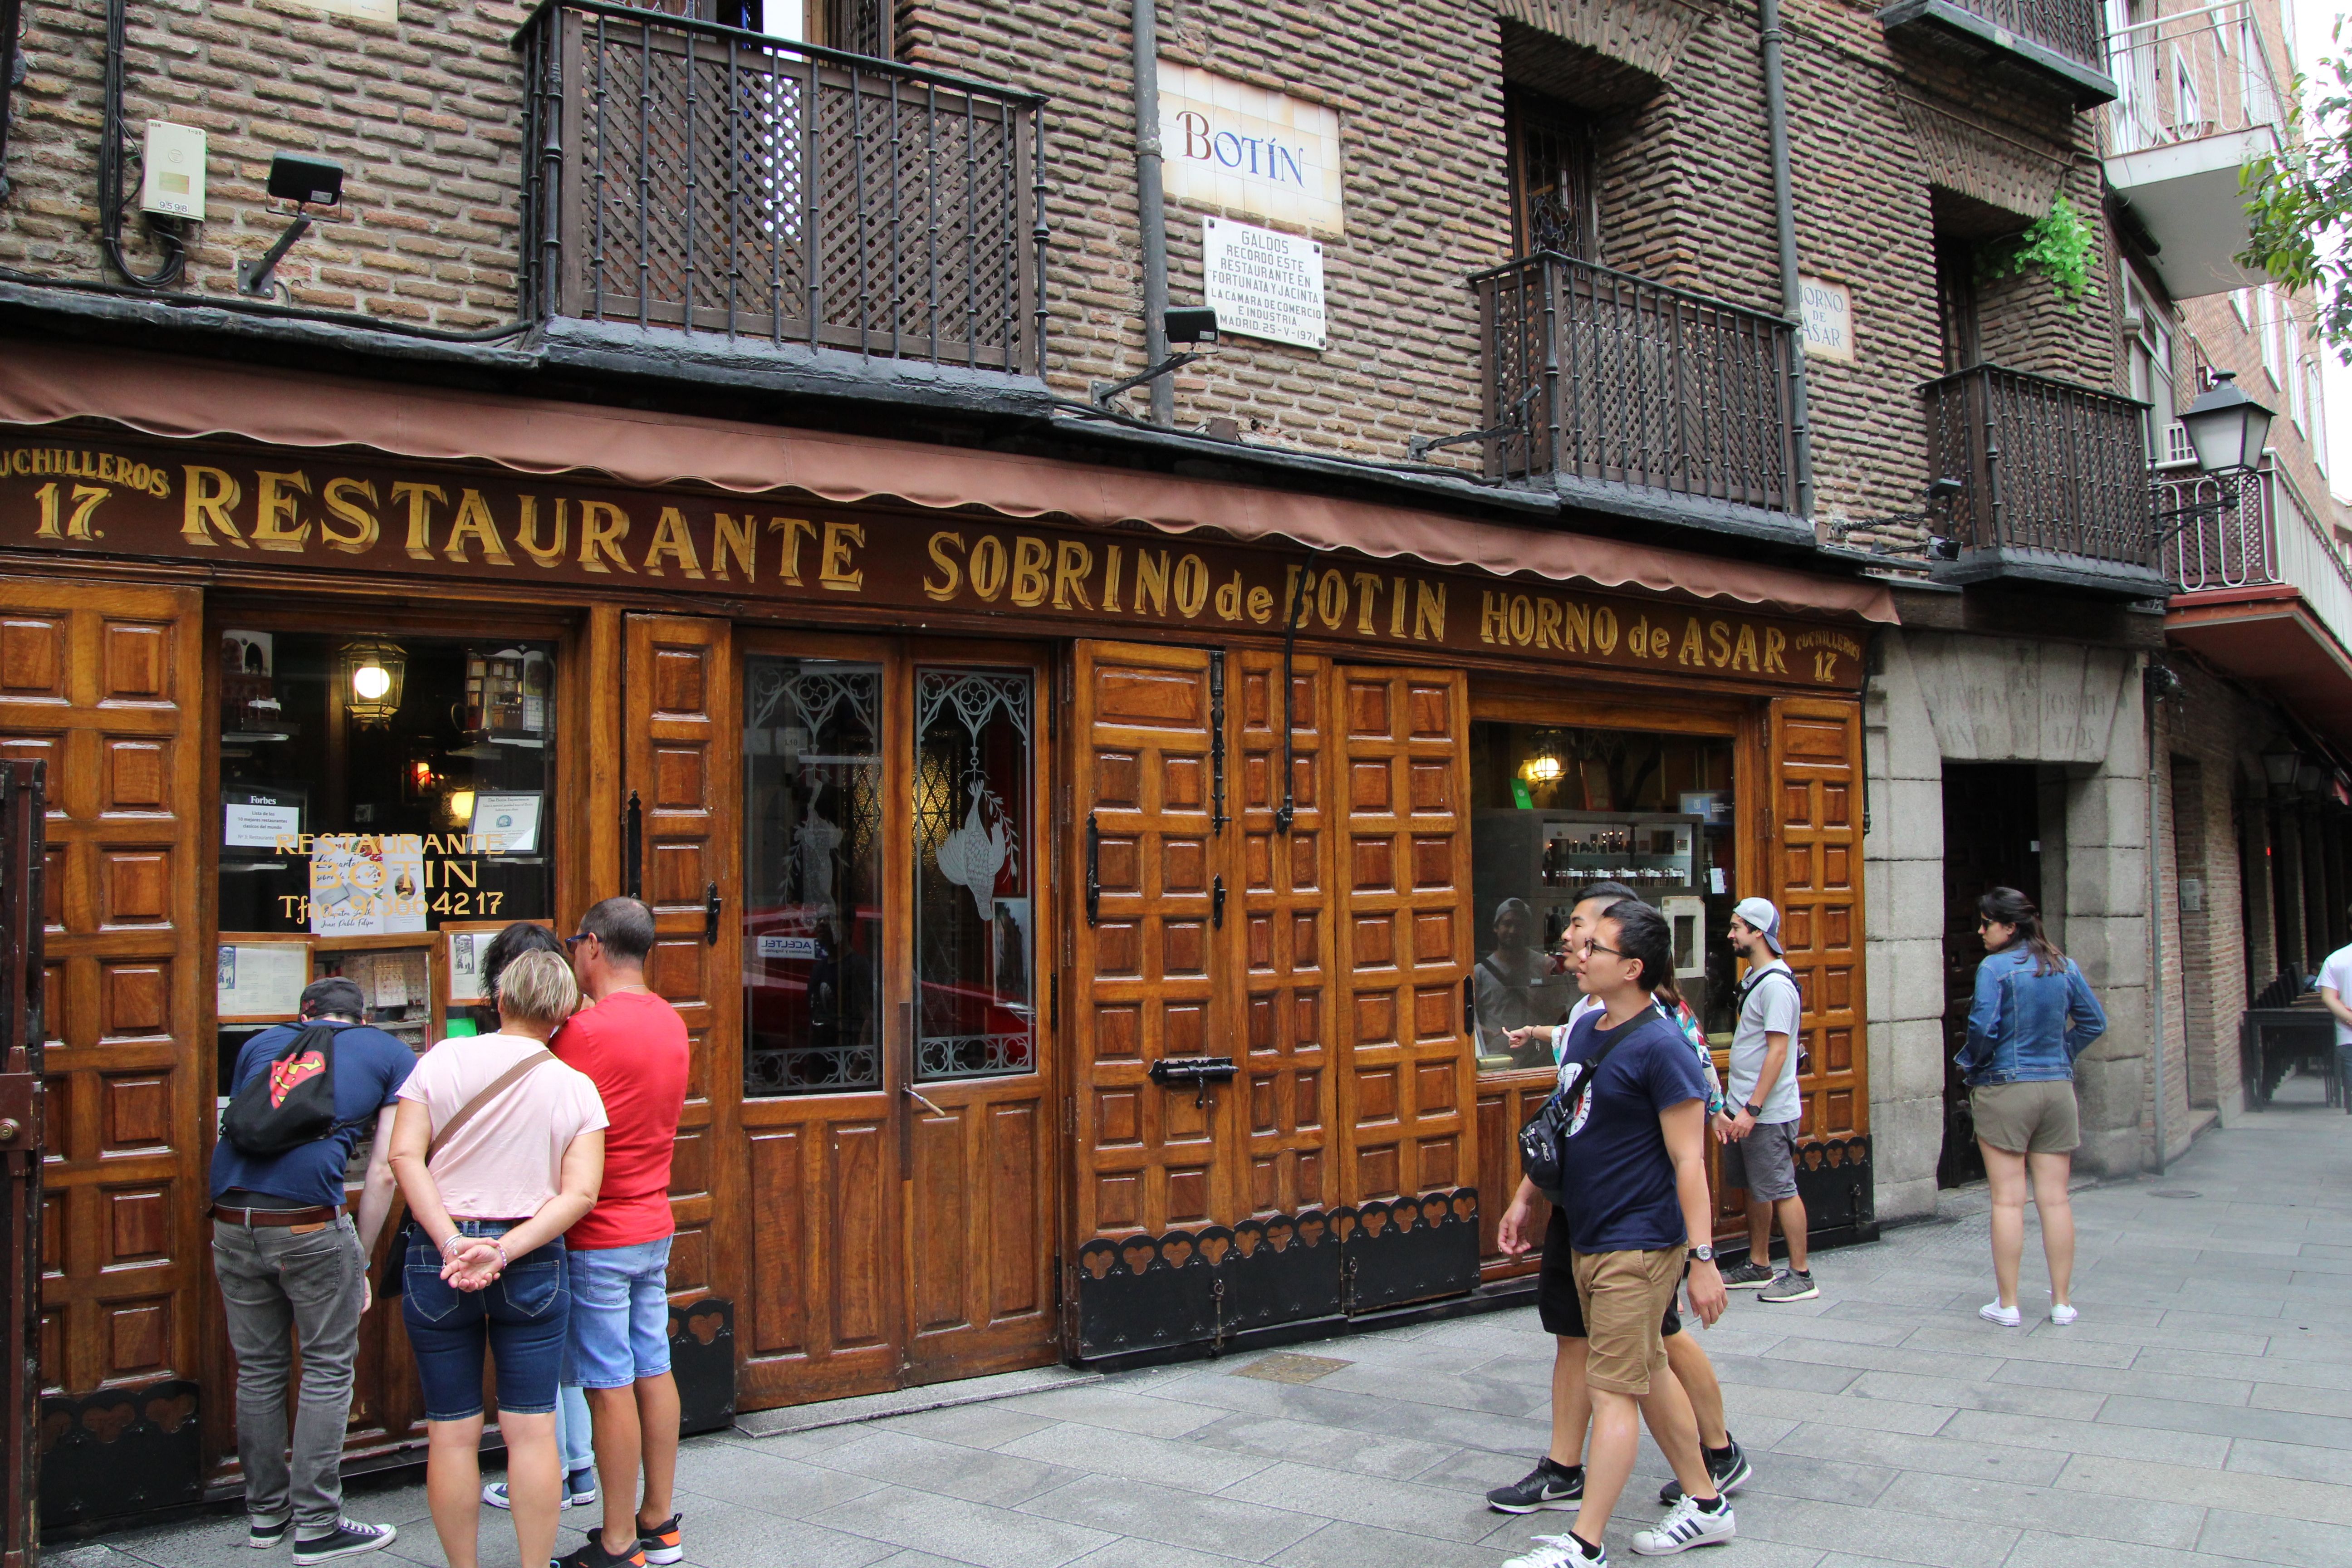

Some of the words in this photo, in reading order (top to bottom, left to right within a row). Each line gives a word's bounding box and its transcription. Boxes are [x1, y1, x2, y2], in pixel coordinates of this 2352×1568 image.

[1176, 111, 1305, 189] BOTÍN
[159, 201, 188, 213] 9598
[1242, 231, 1289, 254] GALDOS
[1220, 257, 1294, 284] RESTAURANTE
[1298, 274, 1311, 288] EN
[1226, 244, 1274, 265] RECORDÓ
[1277, 256, 1304, 272] ESTE
[1211, 288, 1223, 299] LA
[1225, 288, 1262, 307] CÁMARA
[1264, 298, 1275, 309] DE
[1277, 301, 1322, 319] COMERCIO
[1271, 283, 1276, 294] Y
[1238, 305, 1244, 315] E
[1812, 309, 1826, 323] DE
[1802, 315, 1843, 351] ASAR
[0, 448, 172, 499] UCHILLEROS
[180, 464, 865, 592] RESTAURANTE
[923, 531, 1209, 618] SOBRINO
[1215, 568, 1274, 624] de
[1282, 564, 1447, 643] BOTIN
[1480, 590, 1618, 656] HORNO
[1628, 614, 1670, 659] de
[1678, 617, 1789, 675] ASAR
[1795, 630, 1860, 662] CUCHILLEROS
[250, 795, 276, 804] Forbes
[275, 833, 505, 855] RESTAURANTE
[309, 860, 477, 889] BOTIN
